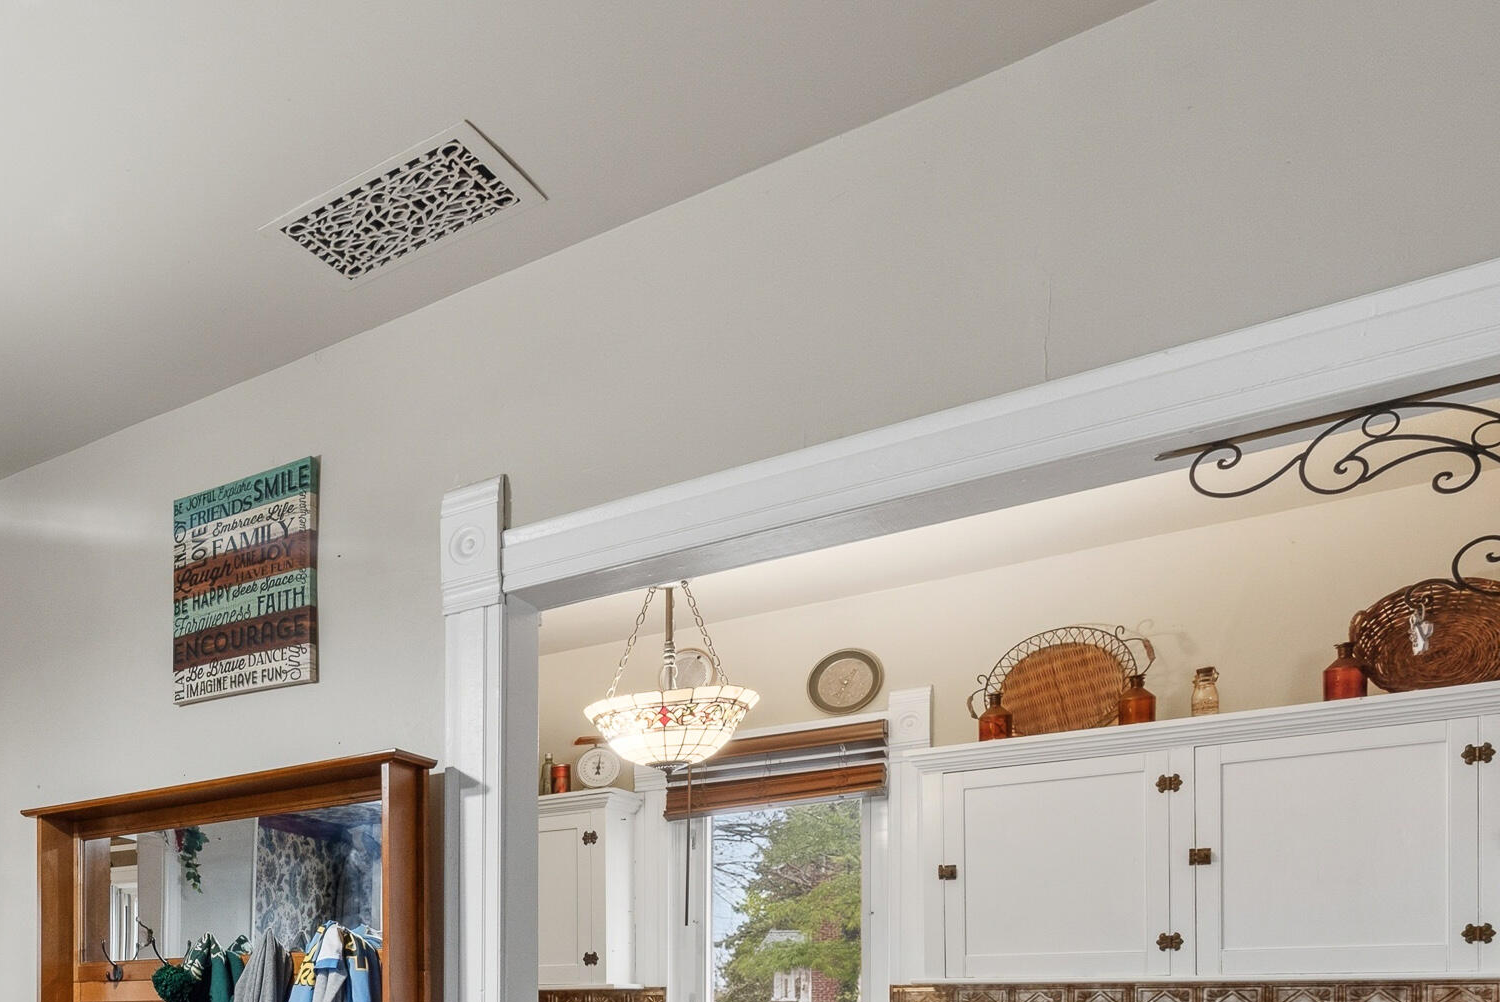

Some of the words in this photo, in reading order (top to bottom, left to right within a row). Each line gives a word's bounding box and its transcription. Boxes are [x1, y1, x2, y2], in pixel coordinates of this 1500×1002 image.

[174, 503, 183, 517] BE
[186, 490, 216, 512] JOYFUL
[218, 479, 253, 501] Explore
[254, 464, 310, 502] SMILE
[189, 495, 253, 529] FRIENDS
[212, 513, 265, 537] Embrace
[265, 502, 296, 522] Life
[173, 520, 187, 571] ENJOY
[191, 525, 208, 570] LOVE
[212, 516, 294, 560] FAMILY
[257, 541, 294, 565] JOY
[176, 560, 233, 594] Laugh
[233, 552, 257, 570] CARE
[236, 566, 268, 582] HAVE
[270, 560, 294, 575] FUN
[174, 599, 189, 616] BE
[192, 584, 233, 612] HAPPY
[232, 581, 259, 600] Seek
[260, 572, 296, 591] Space
[257, 586, 306, 617] FAITH
[173, 604, 252, 638] Forgiveness
[174, 613, 308, 665] ENCOURAGE
[186, 665, 205, 683] Be
[206, 657, 246, 678] Brave
[247, 646, 288, 668] DANCE
[174, 670, 185, 702] PLAY
[186, 676, 229, 699] IMAGINE
[229, 670, 258, 689] HAVE
[260, 665, 284, 682] FUN
